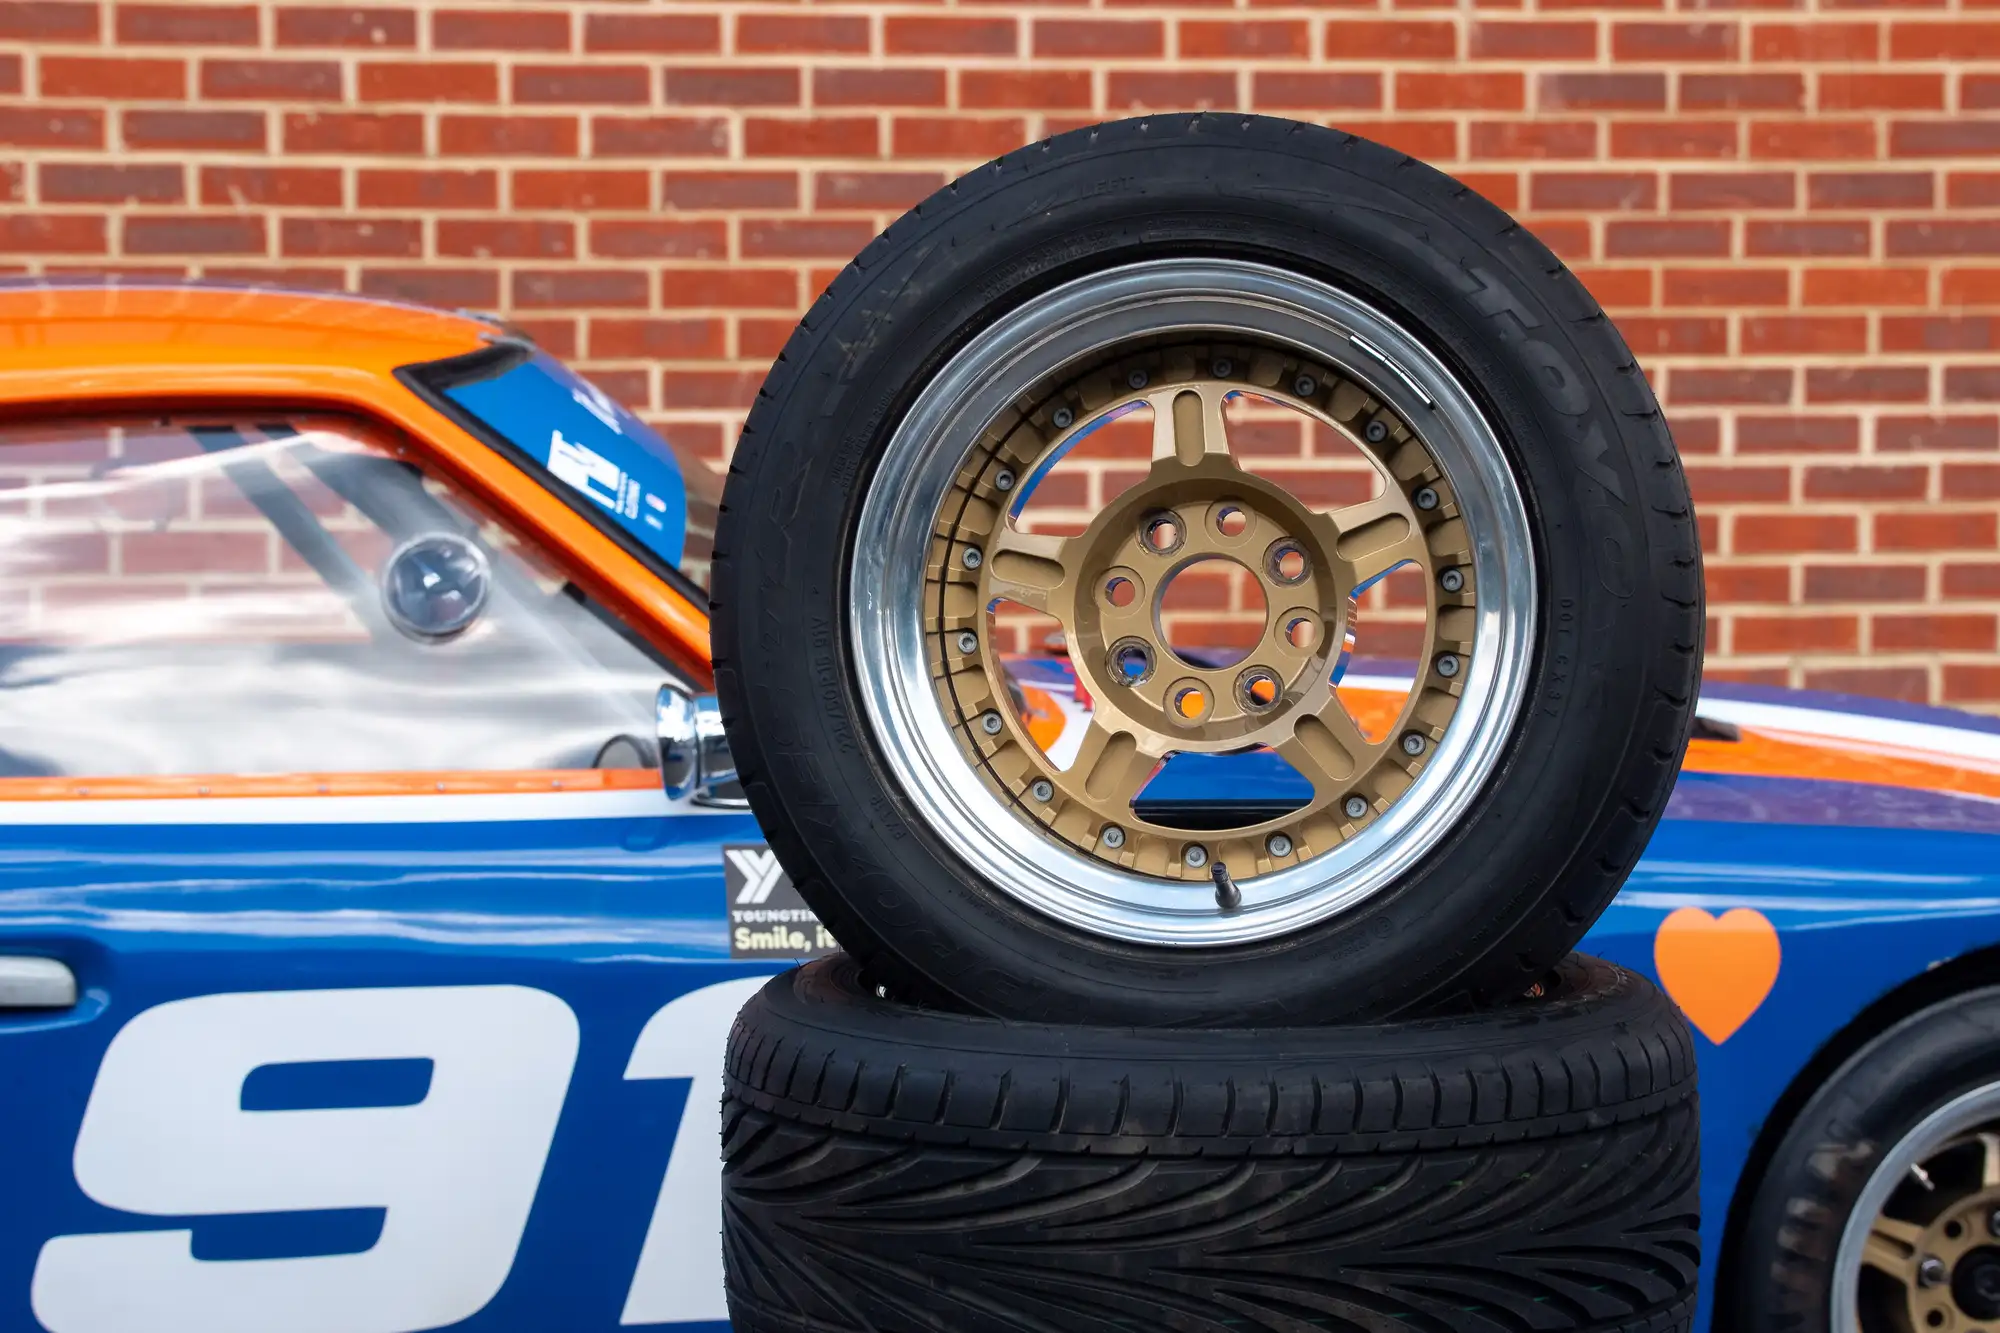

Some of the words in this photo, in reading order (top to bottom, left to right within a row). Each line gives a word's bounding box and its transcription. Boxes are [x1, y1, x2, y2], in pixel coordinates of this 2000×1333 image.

[1463, 265, 1637, 599] TOYO
[735, 925, 812, 953] Smile,
[31, 977, 775, 1333] 91
